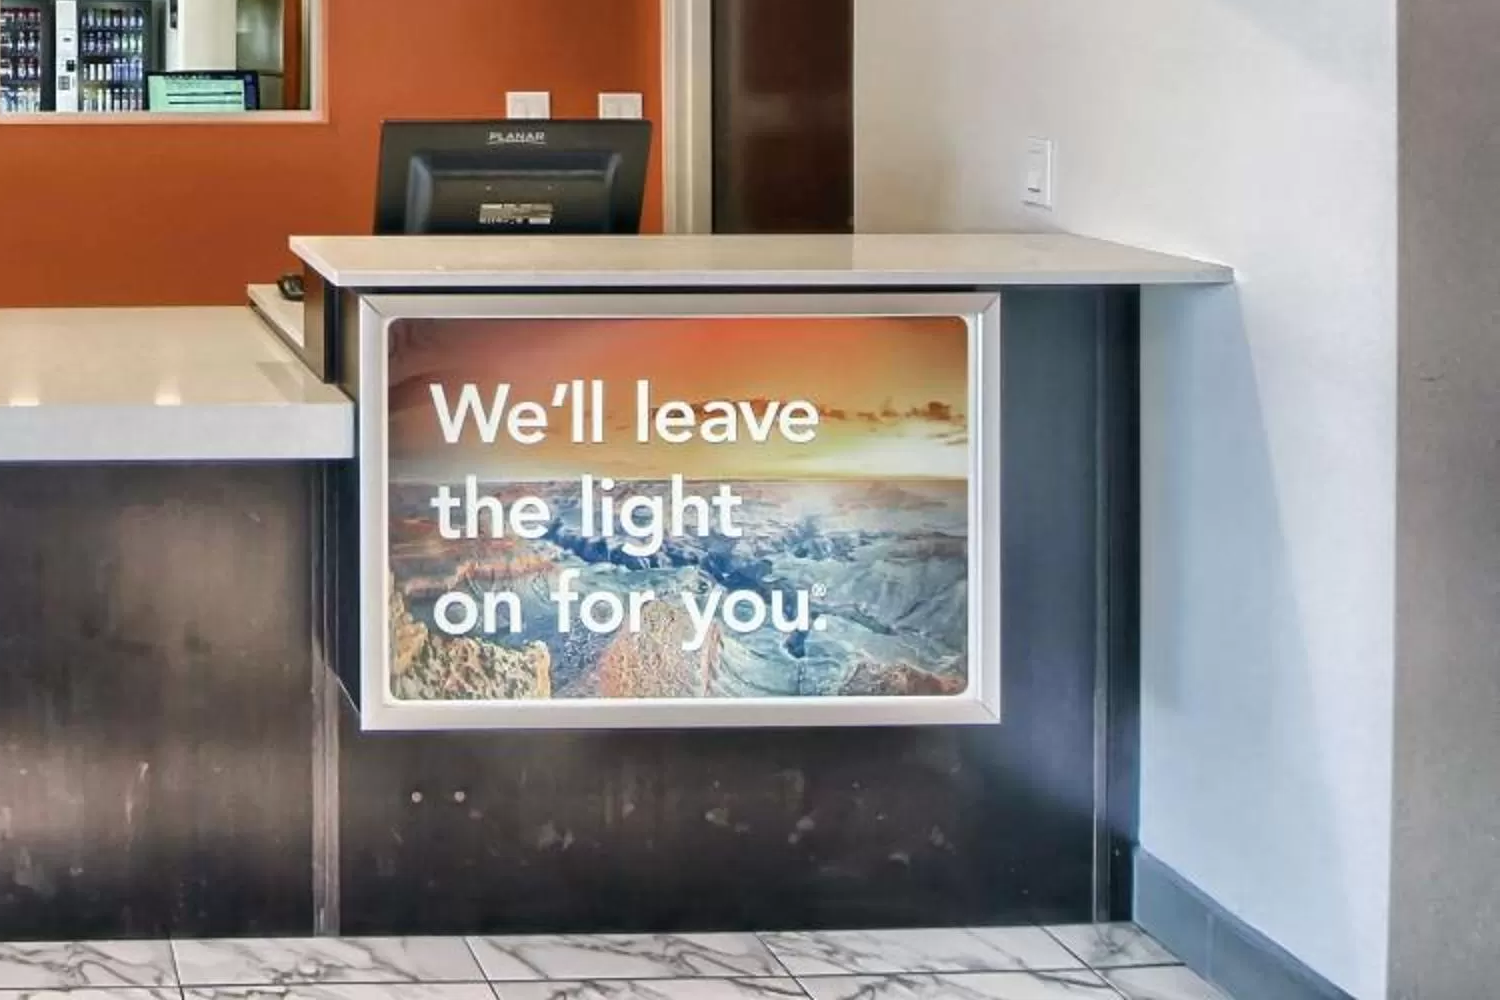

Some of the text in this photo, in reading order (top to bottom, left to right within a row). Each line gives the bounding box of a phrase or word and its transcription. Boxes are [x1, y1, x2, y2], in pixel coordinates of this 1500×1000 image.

[489, 131, 546, 143] PLANAR
[428, 378, 821, 444] We'll leave
[430, 474, 743, 556] the light
[432, 589, 523, 636] on
[550, 569, 656, 634] for
